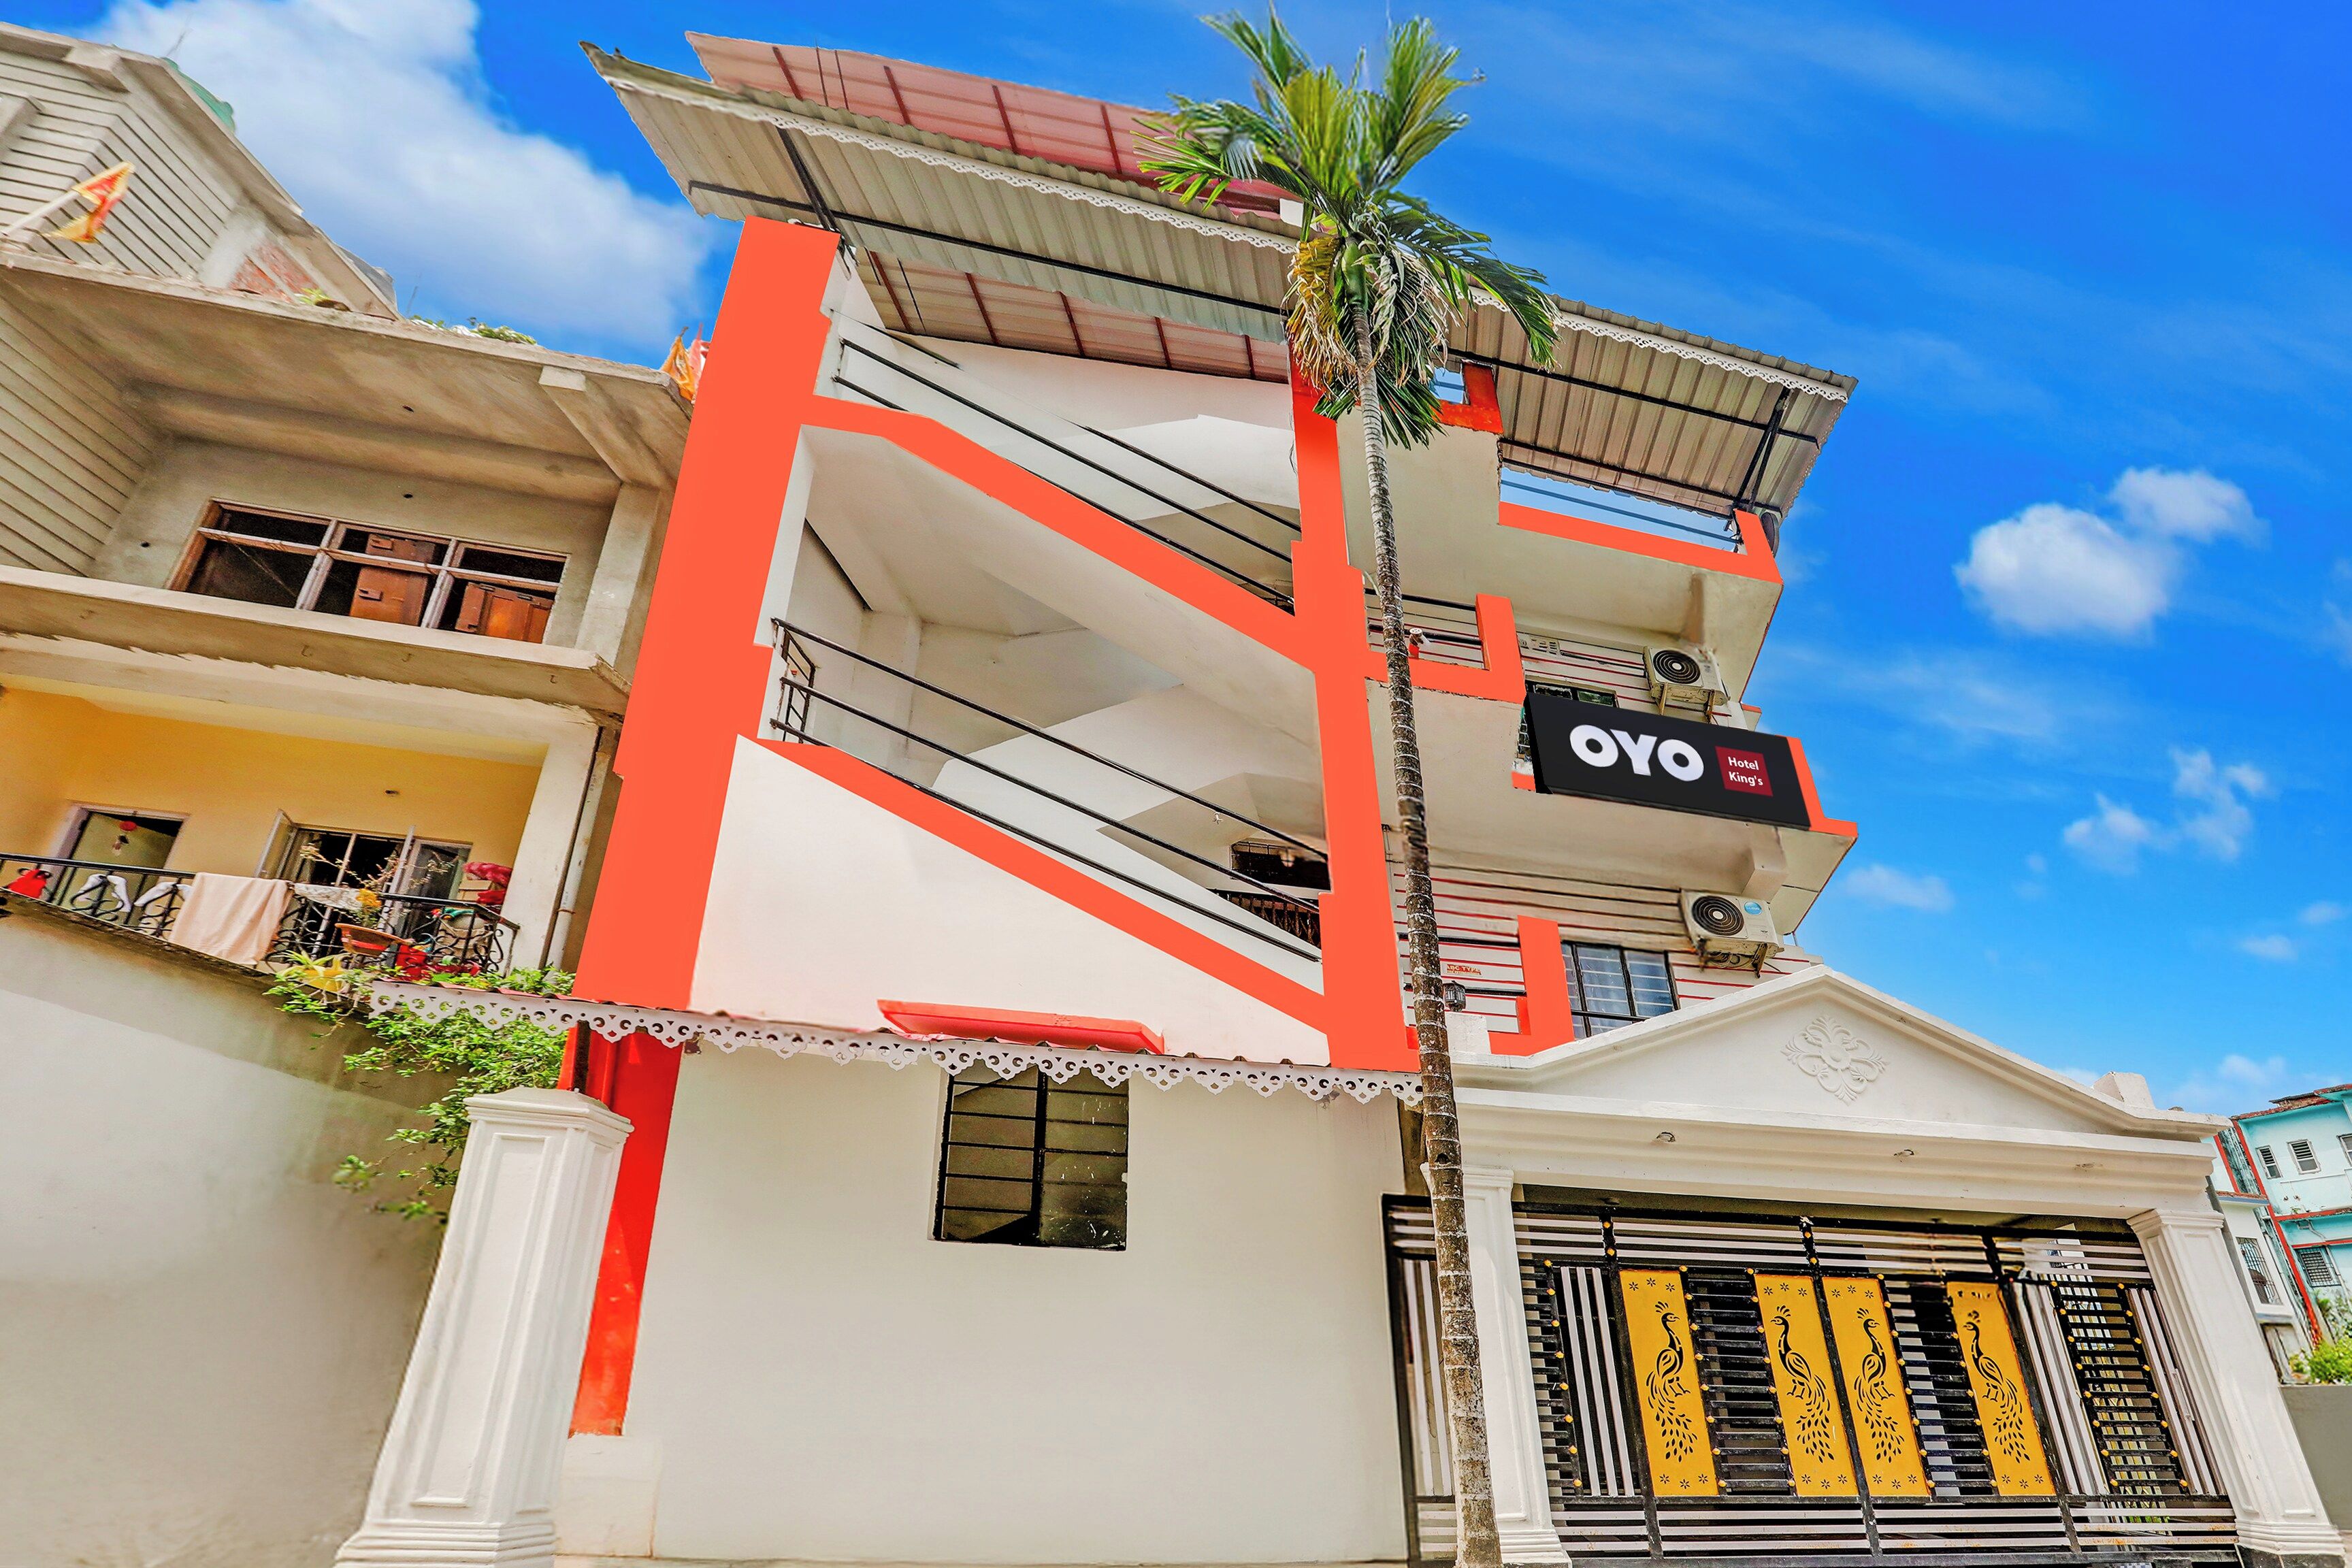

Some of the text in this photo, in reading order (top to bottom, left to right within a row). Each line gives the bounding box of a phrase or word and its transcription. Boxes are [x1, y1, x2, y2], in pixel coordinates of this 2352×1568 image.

[1569, 724, 1704, 781] OYO
[1728, 756, 1759, 770] Hotel
[1729, 771, 1763, 787] King's
